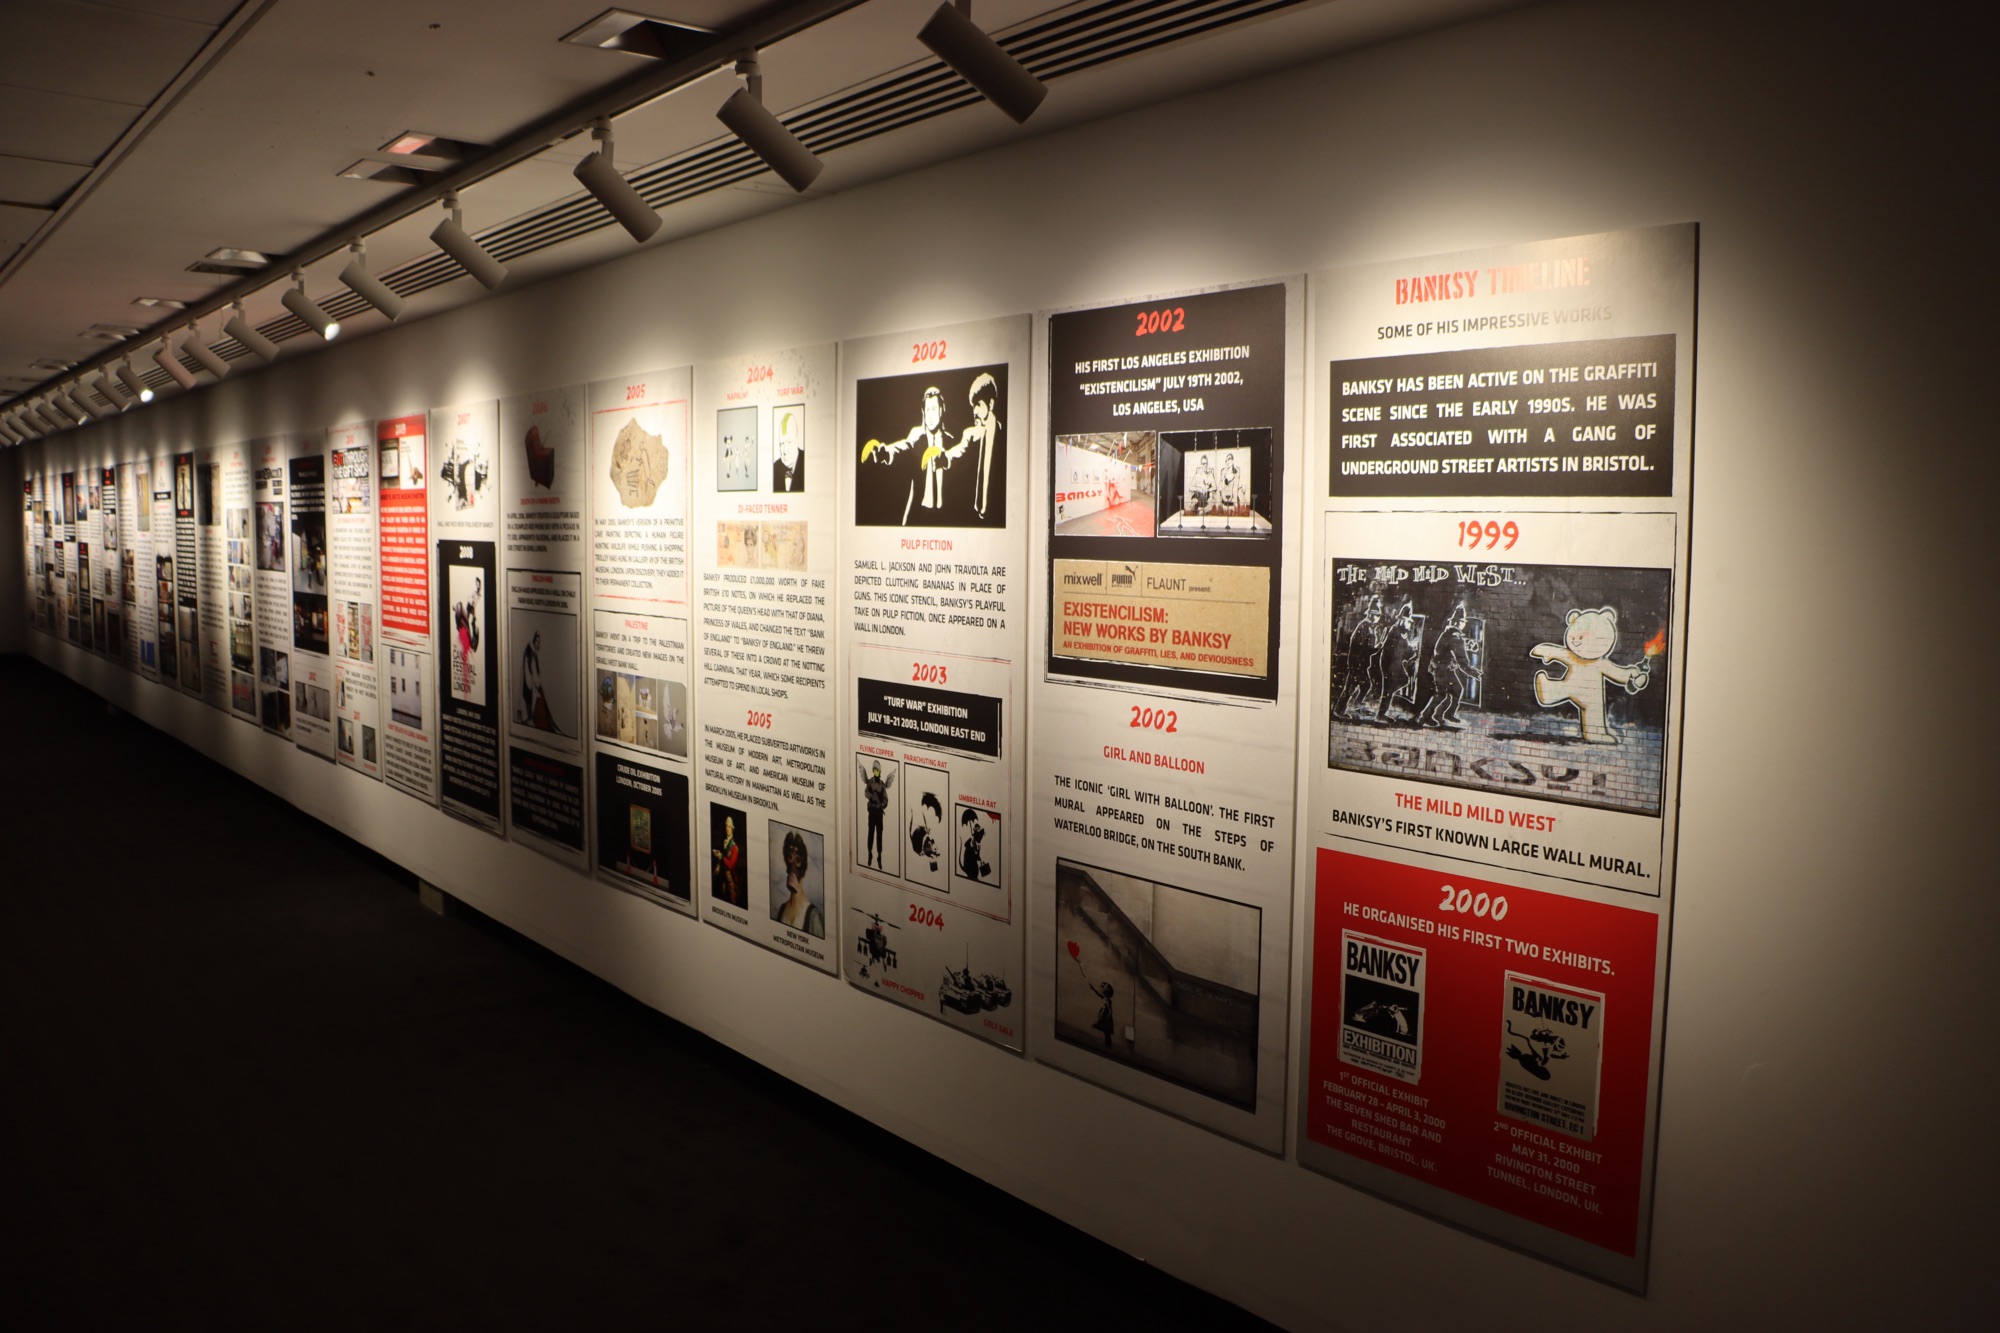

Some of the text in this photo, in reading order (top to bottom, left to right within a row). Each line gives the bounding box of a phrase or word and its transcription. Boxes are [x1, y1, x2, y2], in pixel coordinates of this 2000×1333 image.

[1395, 256, 1590, 305] BANKSY TIMELINE
[1135, 307, 1185, 336] 2002
[1378, 306, 1613, 339] SOME OF HIS IMPRESSIVE WORKS
[912, 340, 947, 363] 2002
[1076, 346, 1249, 373] HIS FIRST LOS ANGELES EXHIBITION
[747, 365, 774, 384] 2004
[1163, 376, 1185, 391] JULY
[1187, 374, 1212, 387] 19TH
[1215, 372, 1243, 385] 2002,
[1343, 363, 1656, 395] BANKSY HAS BEEN ACTIVE ON THE GRAFFITI
[626, 384, 646, 400] 2005
[777, 386, 804, 397] TURF WAR
[1113, 398, 1204, 416] LOS ANGELES, USA
[1342, 393, 1656, 422] SCENE SINCE THE EARLY 1990S. HE WAS
[1342, 424, 1656, 448] FIRST ASSOCIATED WITH A GANG OF
[1342, 456, 1654, 474] UNDERGROUND STREET ARTISTS IN BRISTOL.
[764, 504, 787, 513] TENNER
[901, 539, 952, 550] PULP FICTION
[1458, 519, 1520, 551] 1999
[1064, 572, 1102, 586] mixwell
[1112, 573, 1132, 585] PUMA
[1147, 577, 1186, 592] FLAUNT
[1337, 565, 1527, 587] THE MILD MILD WEST...
[1064, 602, 1168, 622] EXISTENCILISM:
[1064, 621, 1231, 649] NEW WORKS BY BANKSY
[1074, 642, 1111, 652] EXHIBITION
[1113, 645, 1122, 653] OF
[1125, 647, 1158, 657] GRAFFITI,
[1160, 650, 1178, 659] LIES,
[1180, 652, 1196, 661] AND
[1198, 654, 1254, 666] DEVIOUSNESS
[912, 663, 947, 684] 2003
[747, 710, 772, 729] 2005
[928, 703, 967, 718] EXHIBITION
[1130, 706, 1178, 733] 2002
[868, 712, 882, 723] JULY
[901, 718, 919, 731] 2003,
[921, 722, 949, 735] LONDON
[951, 726, 969, 738] EAST
[971, 730, 985, 742] END
[860, 745, 894, 757] FLYING COPPER
[904, 754, 936, 766] PARACHUTING
[1104, 746, 1204, 773] GIRL AND BALLOON
[959, 795, 996, 808] UMBRELLA RAT
[1055, 775, 1070, 788] THE
[1075, 780, 1103, 794] ICONIC
[1135, 791, 1160, 805] WITH
[1219, 807, 1239, 821] THE
[1244, 812, 1275, 828] FIRST
[1395, 793, 1556, 832] THE MILD MILD WEST
[1396, 821, 1432, 838] FIRST
[1436, 829, 1488, 848] KNOWN
[1493, 838, 1539, 858] LARGE
[1543, 847, 1585, 866] WALL
[1589, 855, 1650, 877] MURAL.
[1438, 885, 1509, 921] 2000
[732, 915, 748, 925] MUSEUM
[909, 904, 944, 931] 2004
[773, 936, 824, 960] METROPOLITAN MUSEUM
[1344, 902, 1614, 974] HE ORGANISED HIS FIRST TWO EXHIBITS.
[1347, 942, 1420, 986] BANKSY
[882, 979, 924, 1000] HAPPY CHOPPER
[1512, 986, 1595, 1029] BANKSY
[1344, 1030, 1416, 1064] EXHIBITION
[1351, 1076, 1390, 1095] OFFICIAL
[1392, 1089, 1429, 1107] EXHIBIT
[1511, 1127, 1556, 1149] OFFICIAL
[1559, 1142, 1602, 1163] EXHIBIT
[1512, 1143, 1580, 1173] MAY 31, 2000
[1496, 1154, 1596, 1194] RIVINGTON STREET
[1487, 1166, 1603, 1214] TUNNEL, LONDON, UK.
